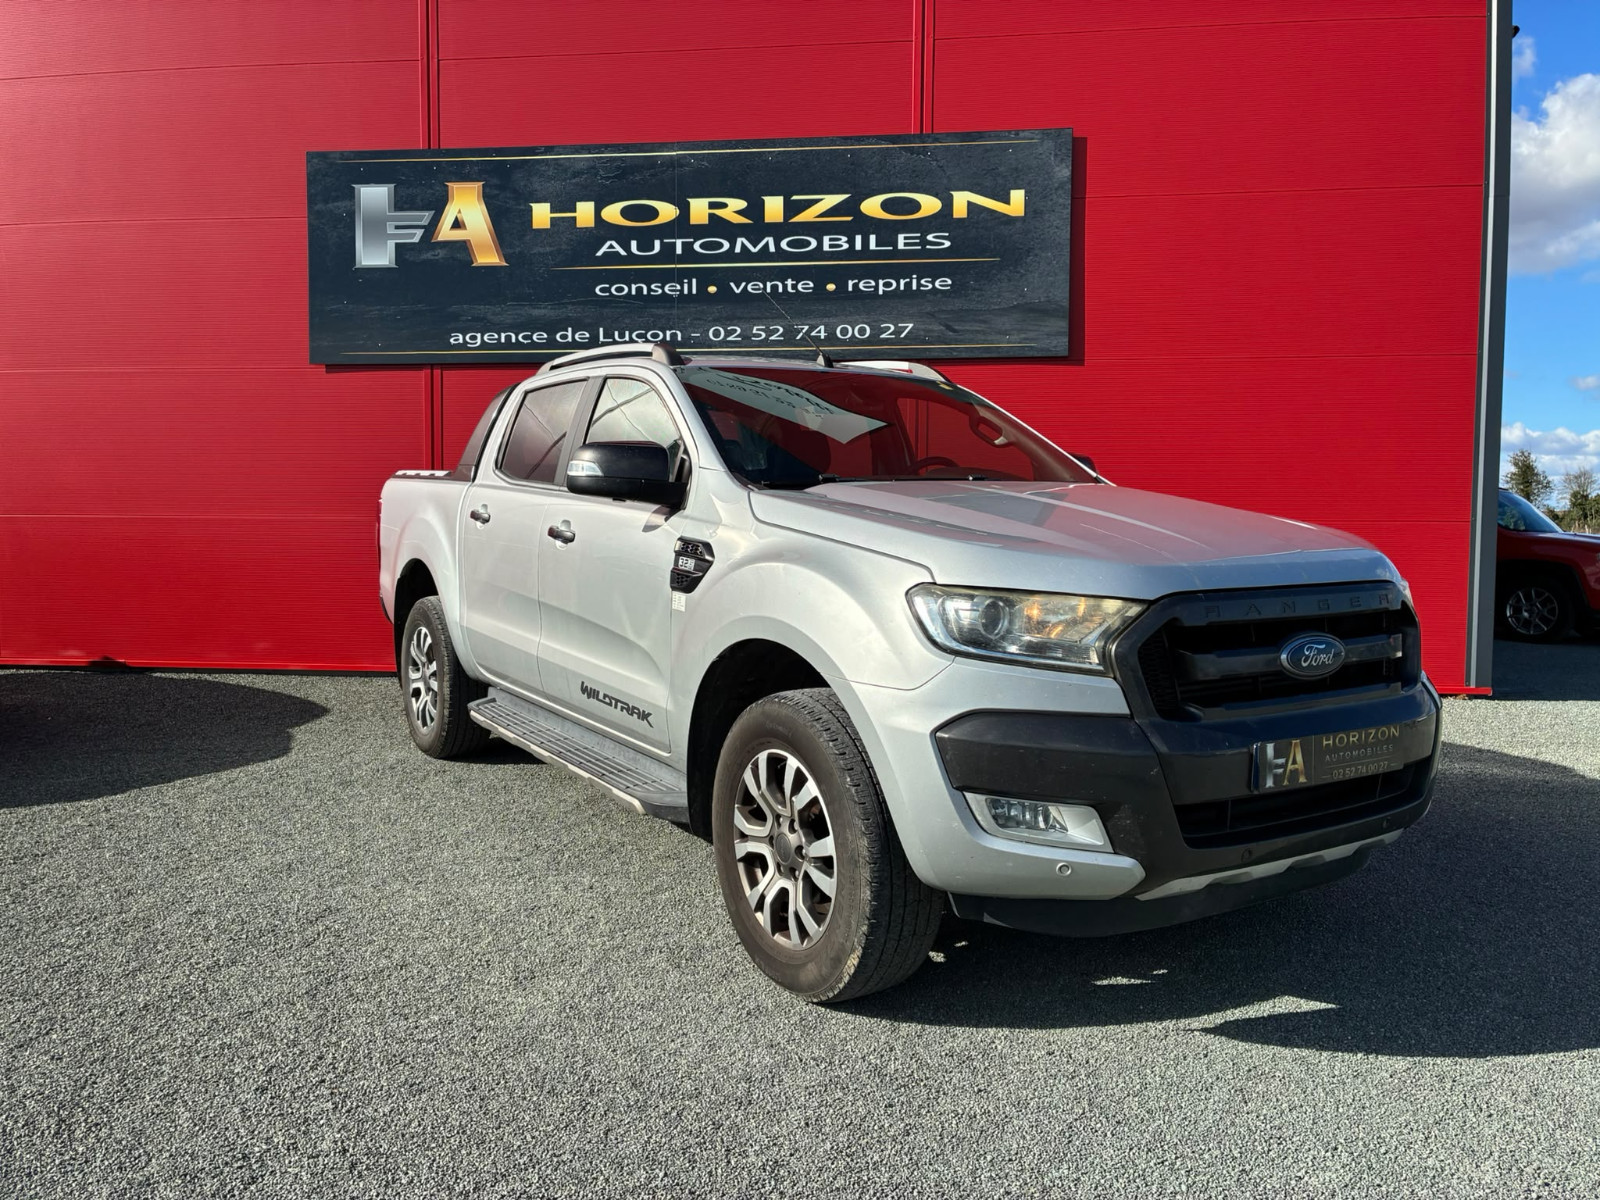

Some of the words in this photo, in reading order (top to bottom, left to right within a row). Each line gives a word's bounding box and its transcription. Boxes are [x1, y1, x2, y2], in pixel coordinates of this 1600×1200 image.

[528, 188, 1026, 230] HORIZON
[595, 231, 952, 258] AUTOMOBILES
[594, 277, 698, 297] conseil
[729, 278, 815, 294] vente
[846, 274, 953, 295] reprise
[449, 331, 547, 348] agence
[556, 326, 591, 343] de
[708, 325, 742, 342] 02
[751, 325, 785, 341] 52
[793, 324, 828, 340] 74
[835, 323, 871, 339] 00
[879, 322, 915, 338] 27
[1205, 594, 1391, 619] RANGER
[1301, 643, 1335, 668] Ford
[580, 681, 653, 728] WILDTRAK
[1322, 725, 1400, 750] HORIZON
[1324, 744, 1394, 763] AUTOMOBILES
[1332, 767, 1344, 780] 02
[1345, 765, 1355, 778] 52
[1357, 763, 1367, 775] 74
[1368, 762, 1378, 774] 00
[1379, 761, 1388, 771] 27
